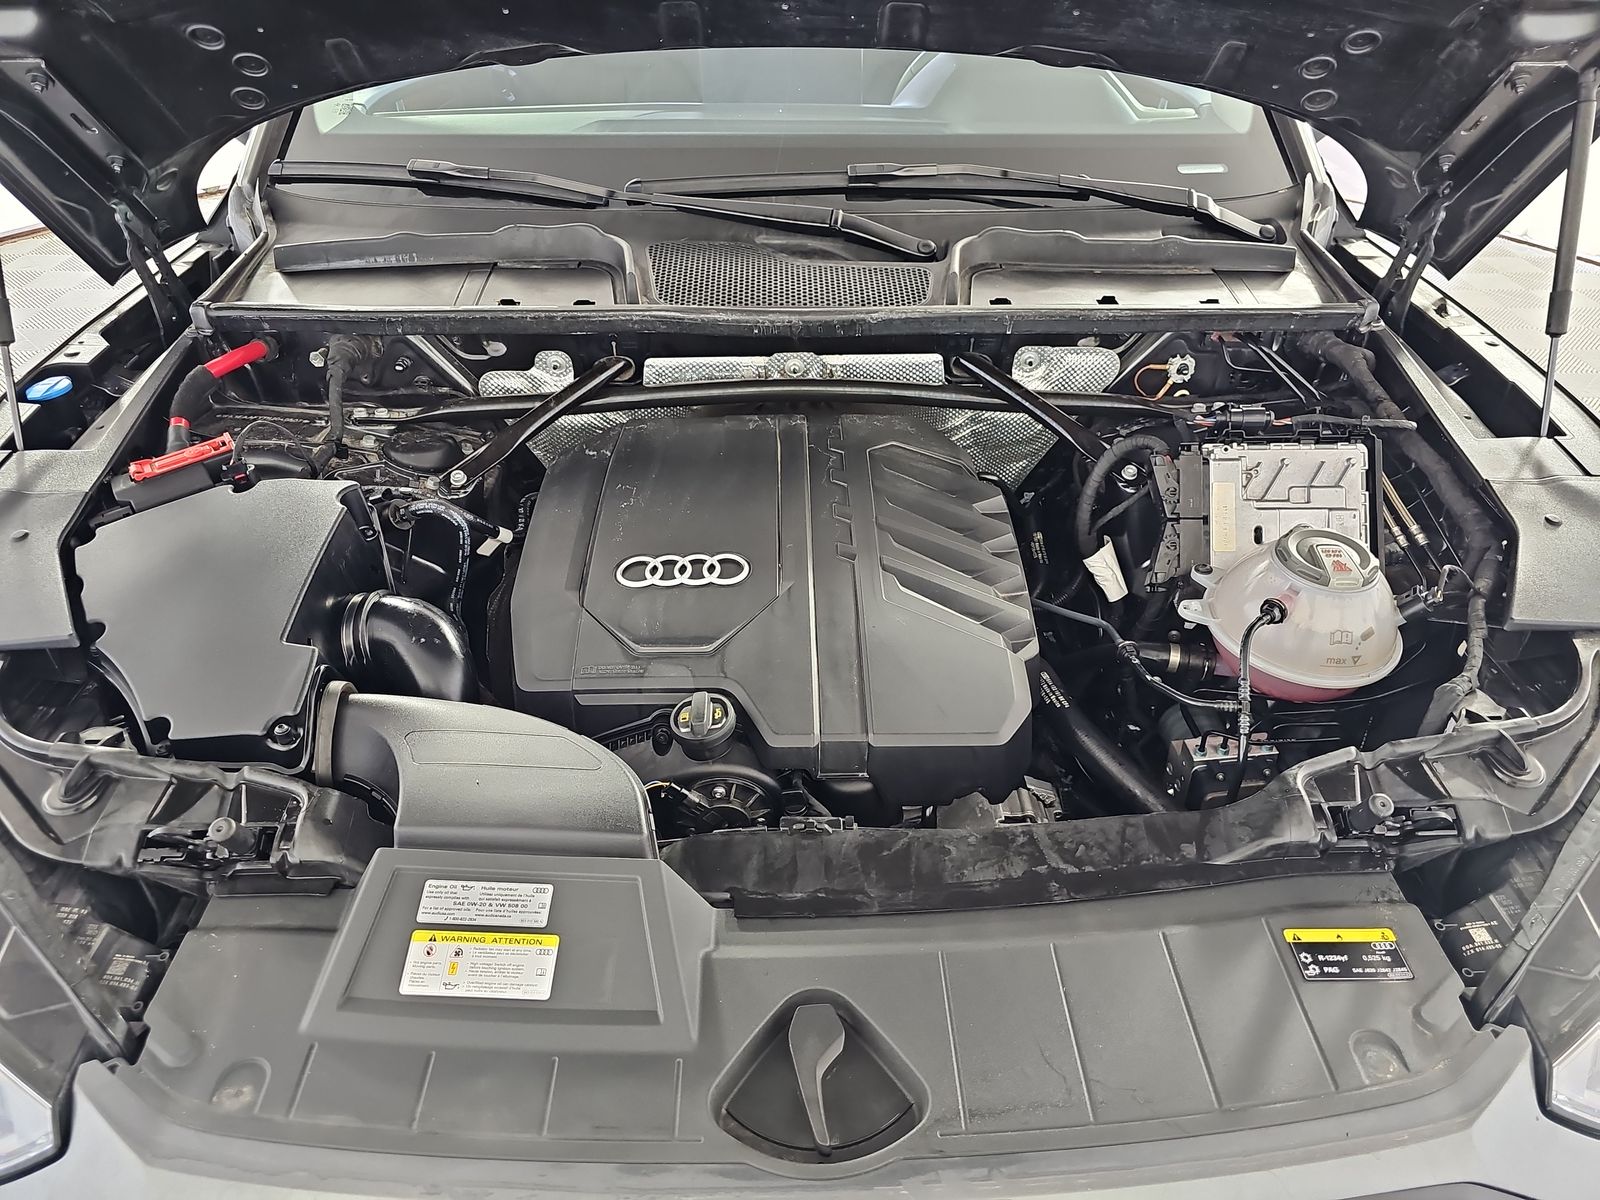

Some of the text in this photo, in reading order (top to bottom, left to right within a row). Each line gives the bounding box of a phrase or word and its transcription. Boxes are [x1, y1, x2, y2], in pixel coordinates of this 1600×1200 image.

[1326, 657, 1347, 665] max
[440, 935, 543, 946] WARNING ATTENTION
